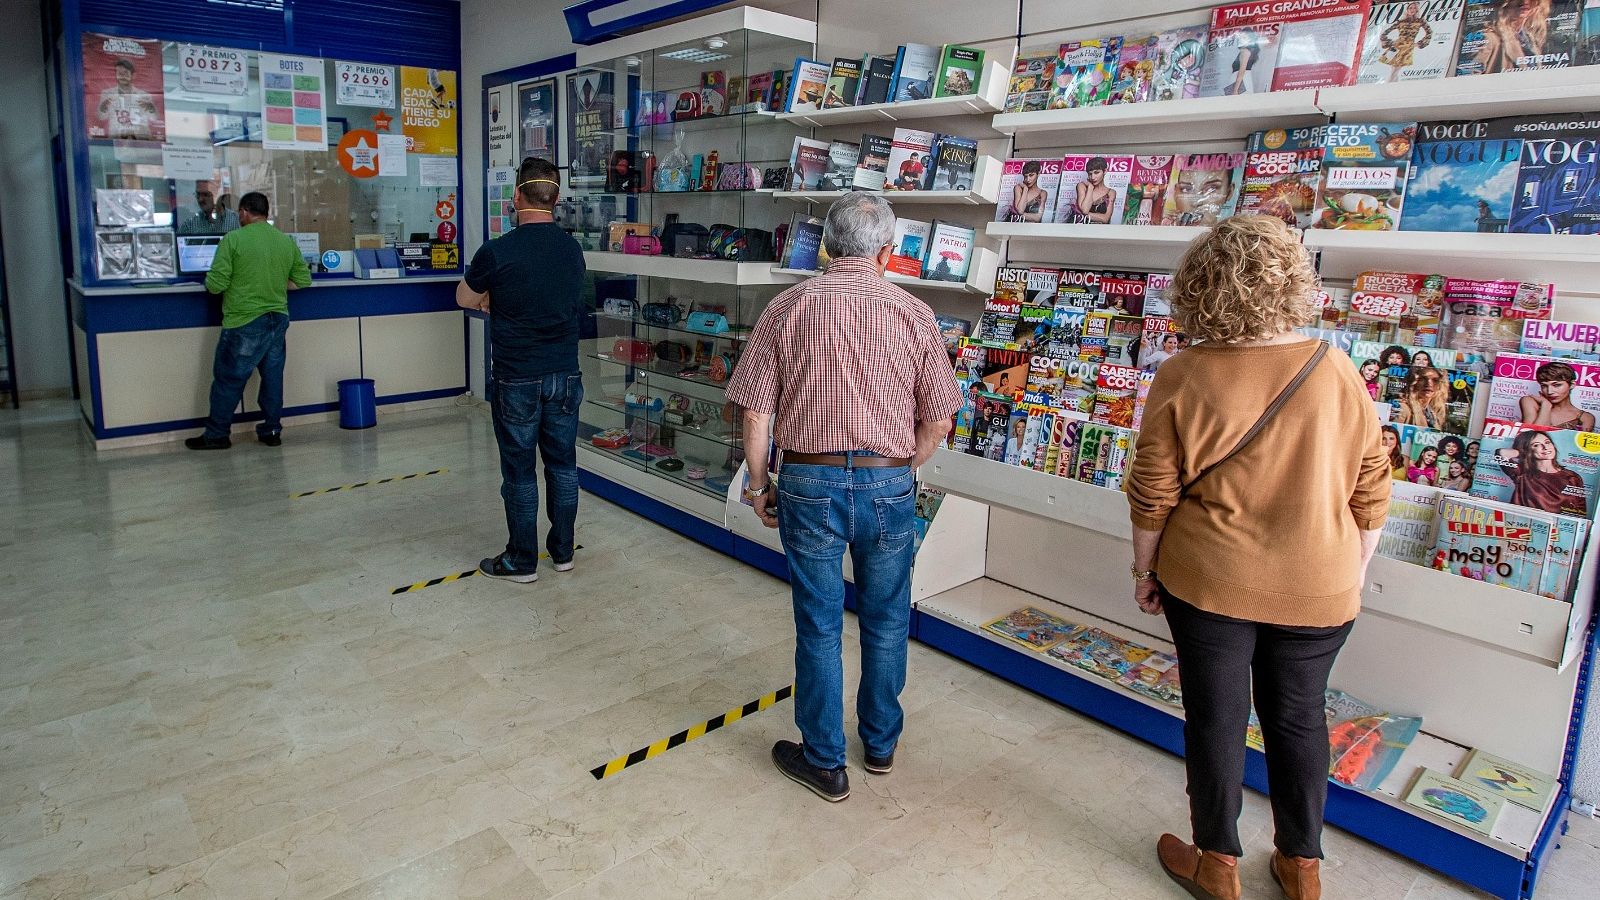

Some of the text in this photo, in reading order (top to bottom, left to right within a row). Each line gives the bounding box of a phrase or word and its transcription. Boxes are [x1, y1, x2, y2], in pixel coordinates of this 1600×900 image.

[1223, 0, 1339, 19] TALLAS GRANDES
[1300, 9, 1325, 17] RENOVAR
[1333, 4, 1360, 13] ARMARIO
[202, 49, 237, 60] PREMIO
[1516, 52, 1569, 65] ESTRENA
[185, 57, 242, 72] 00873
[279, 59, 304, 71] BOTES
[356, 65, 385, 75] PREMIO
[342, 72, 389, 86] 92696
[403, 87, 433, 99] CADA
[403, 107, 451, 118] TIENE SU
[404, 117, 440, 128] JUEGO
[1292, 126, 1378, 140] 50 RECETAS
[1421, 122, 1489, 139] VOGUE
[1310, 135, 1361, 148] HUEVO
[943, 150, 973, 165] KING
[1256, 153, 1297, 164] SABER
[1415, 140, 1521, 164] VOGUE
[1174, 153, 1244, 172] GLAMOUR
[1257, 161, 1320, 174] COCINAR
[1333, 170, 1391, 179] HUEVOS
[940, 238, 968, 249] PATRIA
[1362, 276, 1408, 287] TRUCOS
[1363, 283, 1413, 294] RECETAS
[1351, 291, 1405, 310] Cosas
[984, 301, 1020, 316] Motor 16
[1359, 305, 1402, 319] casa
[1144, 318, 1166, 332] 1976
[1525, 321, 1543, 338] EL
[1024, 393, 1043, 404] más
[1443, 502, 1495, 528] EXTRA
[1448, 545, 1512, 577] mayo
